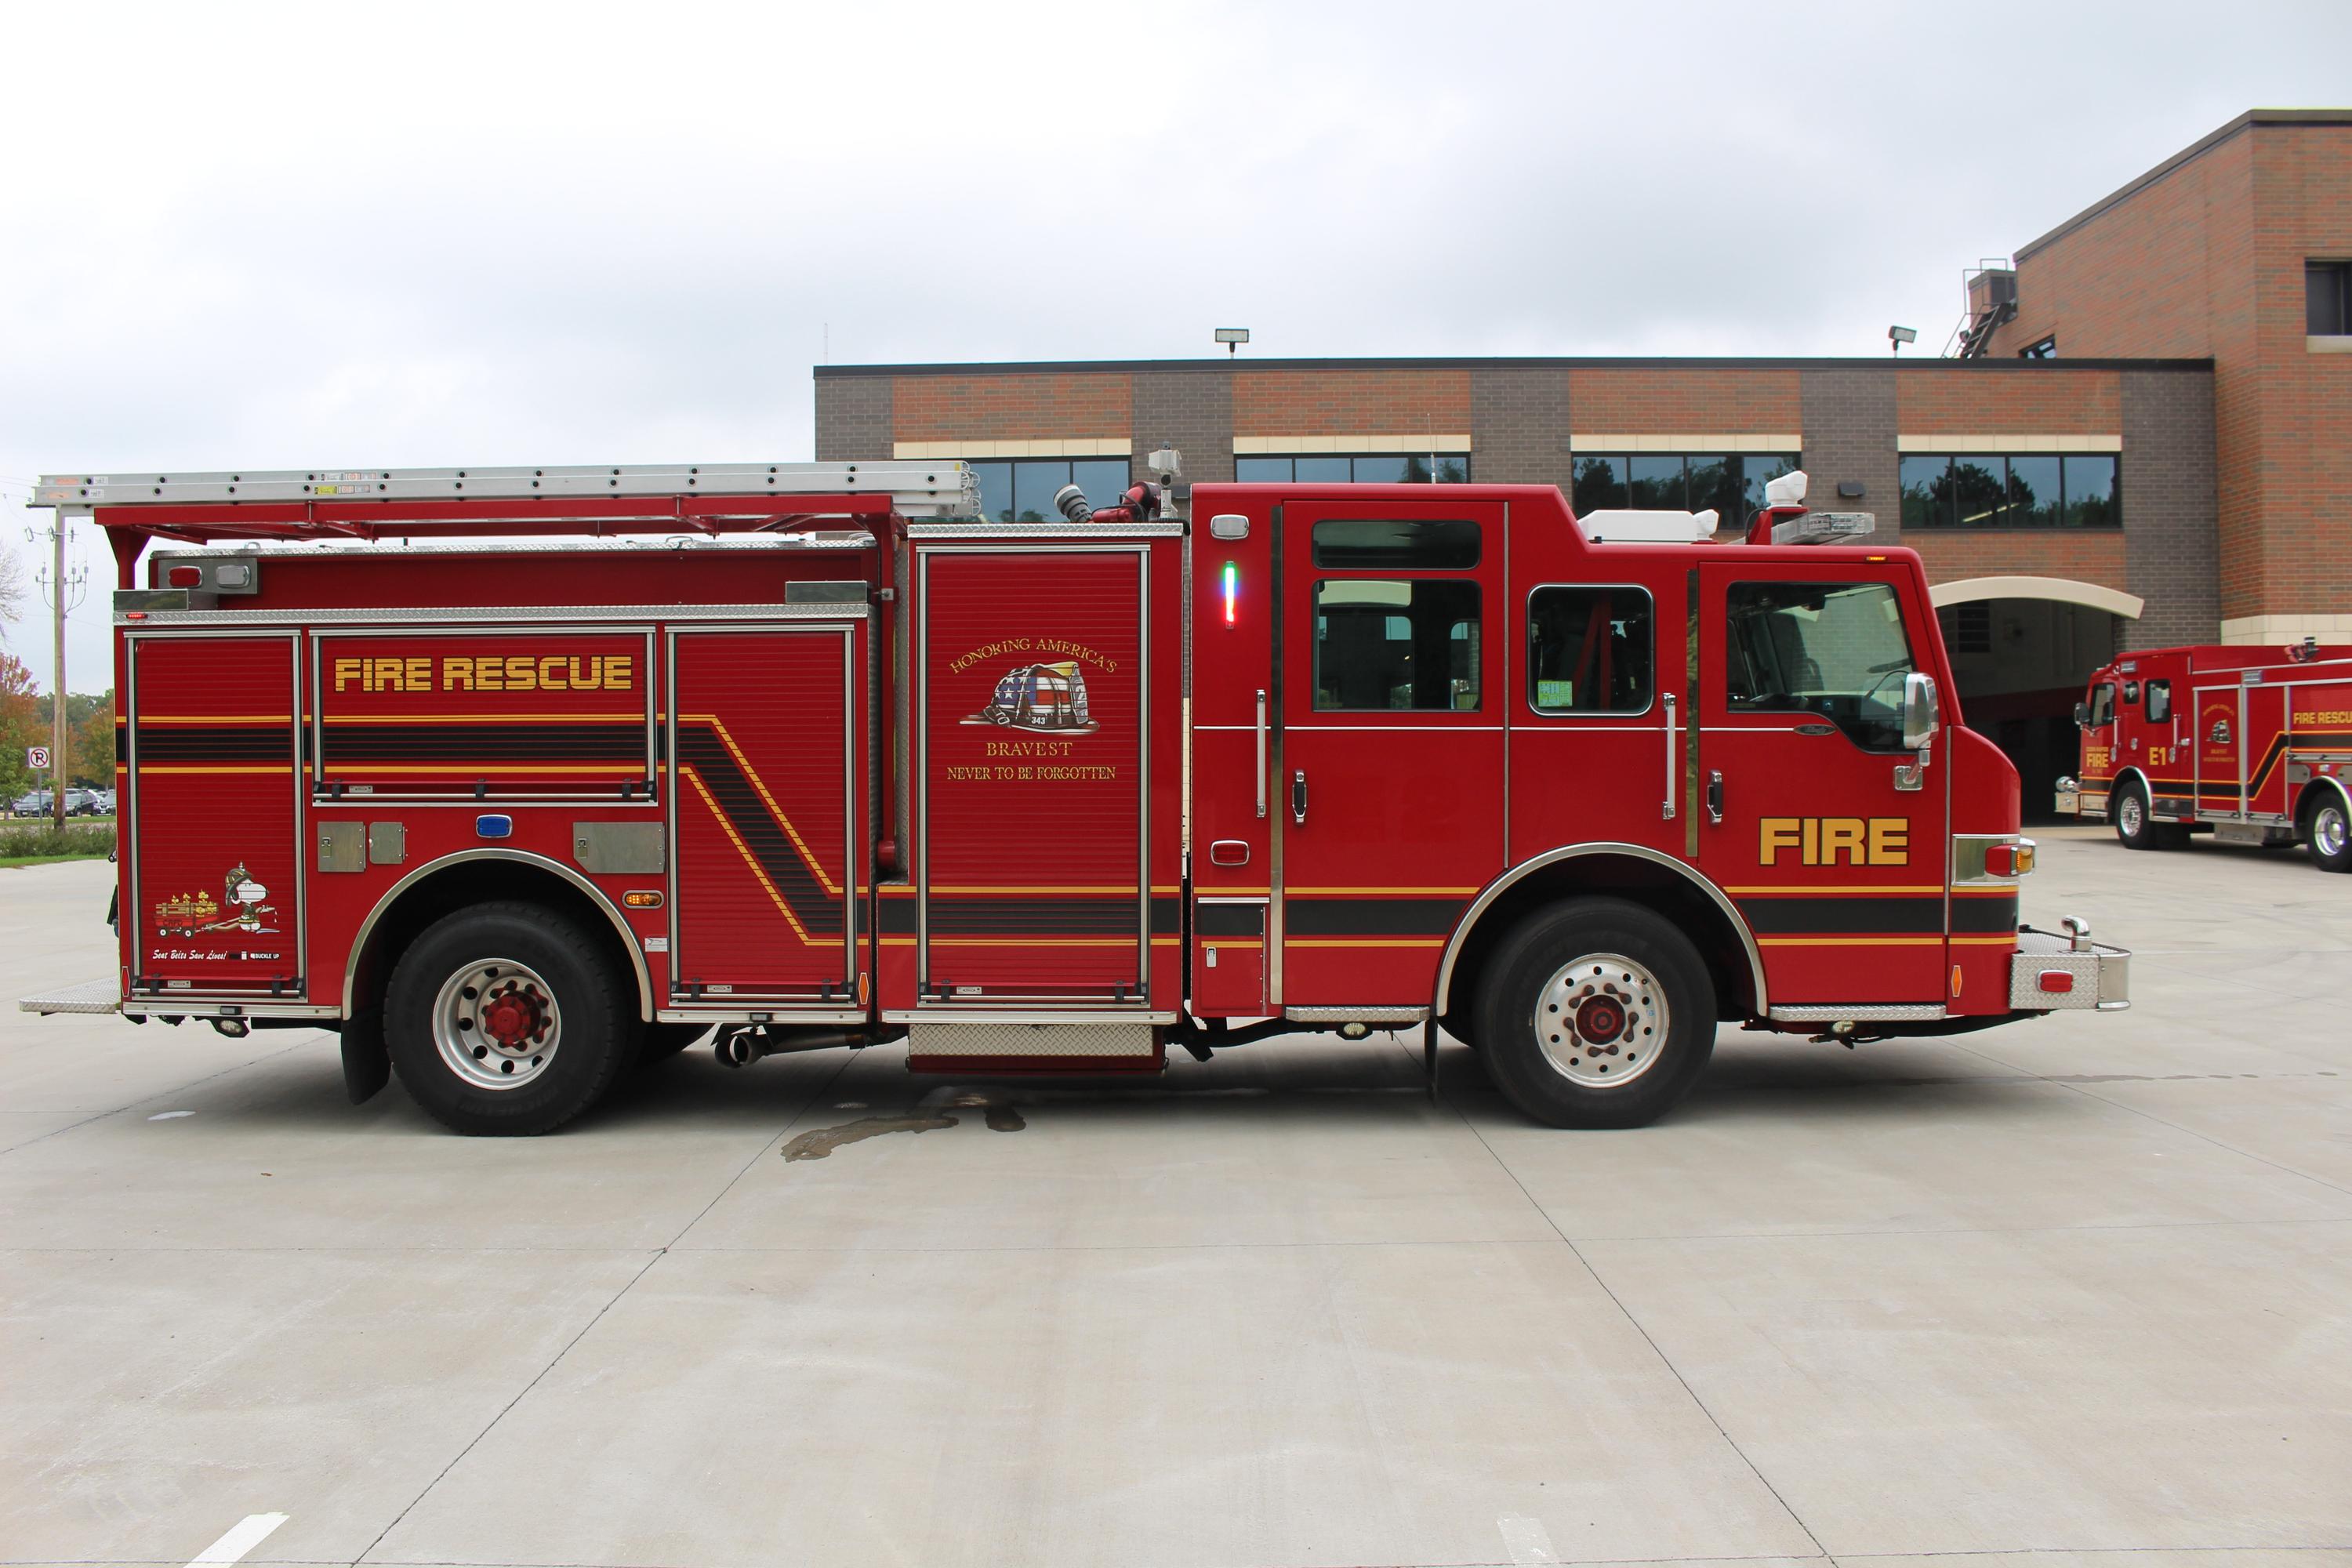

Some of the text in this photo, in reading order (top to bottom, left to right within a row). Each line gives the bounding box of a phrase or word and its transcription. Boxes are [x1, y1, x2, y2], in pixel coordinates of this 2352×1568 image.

[949, 638, 1118, 676] HONORING AMERICA'S
[335, 656, 632, 691] FIRE RESCUE
[1031, 716, 1046, 725] 343
[2293, 711, 2315, 724] FIRE
[985, 742, 1073, 757] BRAVEST
[2149, 746, 2167, 766] E1
[2086, 753, 2109, 768] FIRE
[947, 766, 1117, 780] NEVER TO BE FORGOTTEN
[1759, 817, 1908, 866] FIRE
[152, 949, 168, 960] Seat
[170, 949, 187, 960] Belts
[189, 949, 205, 960] Save
